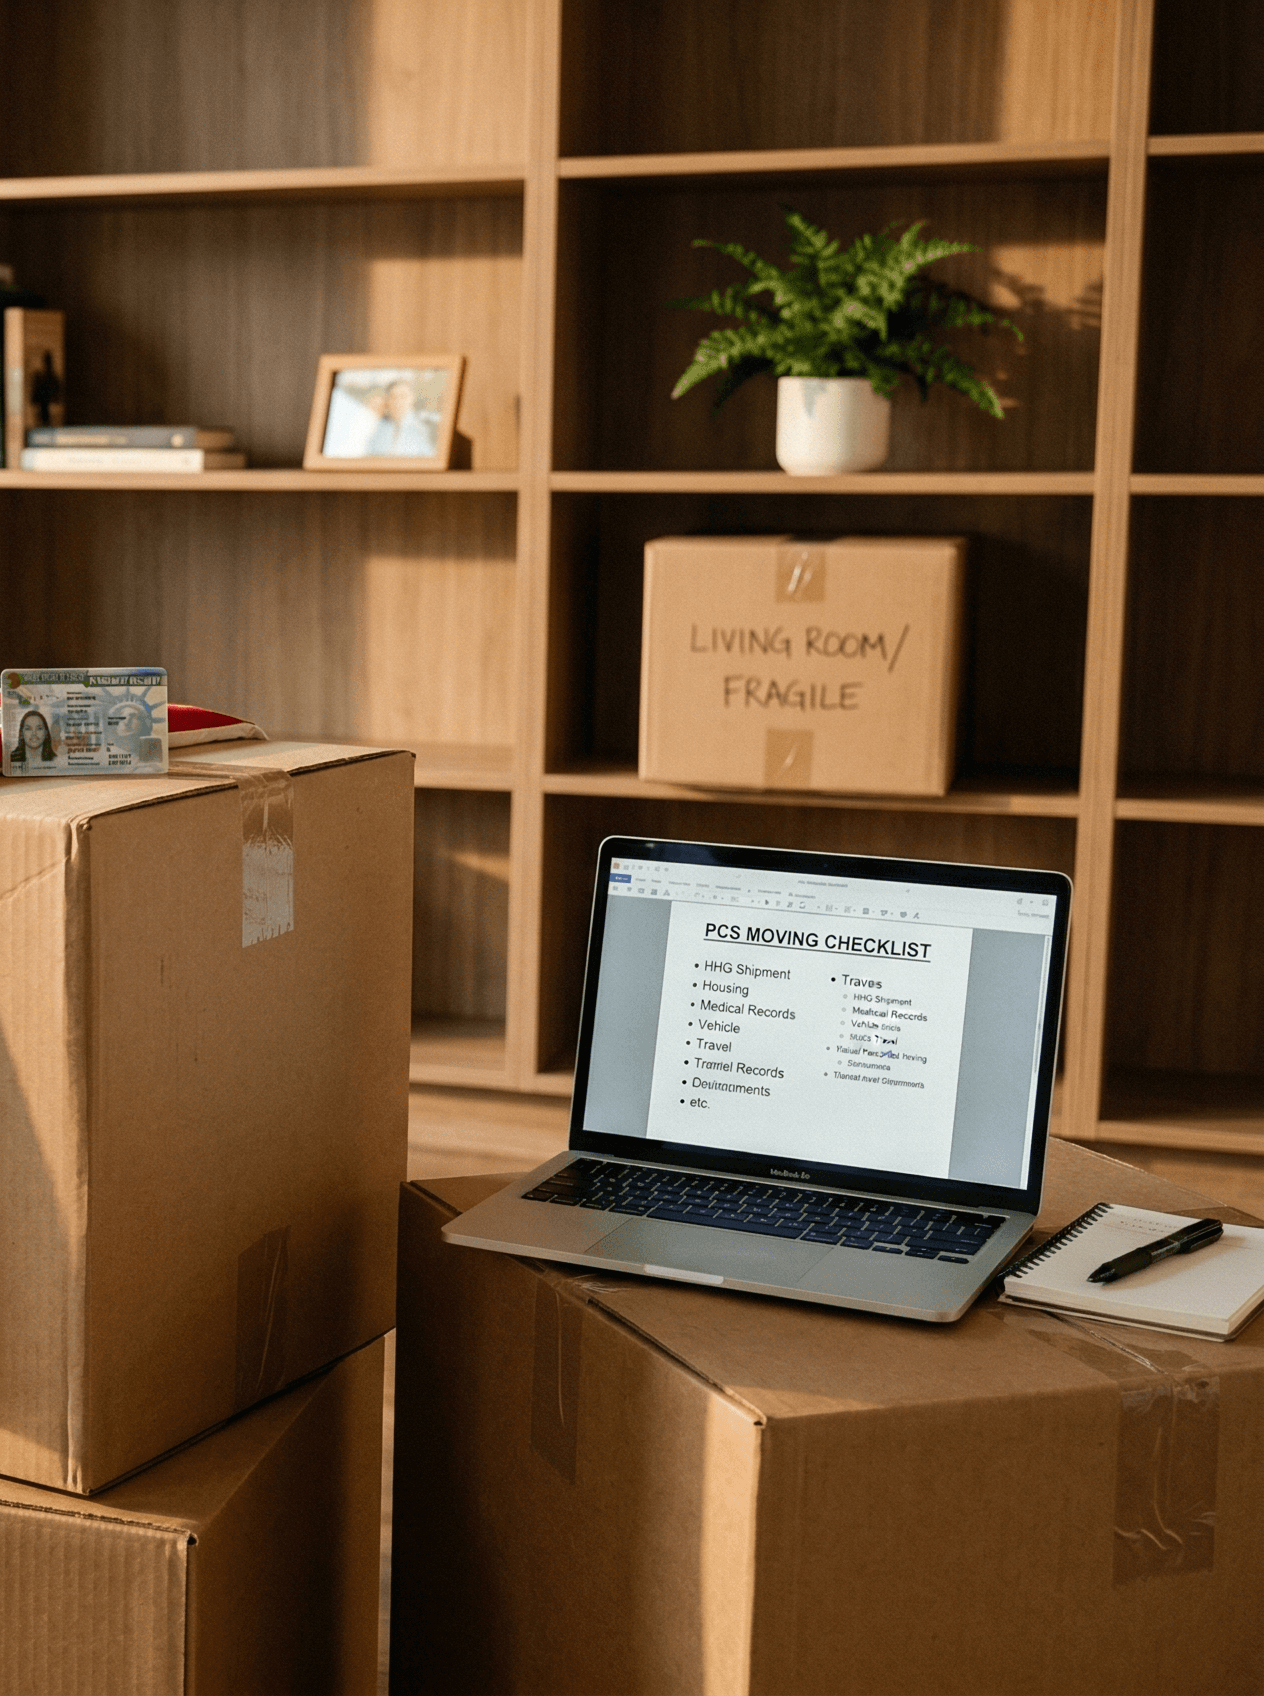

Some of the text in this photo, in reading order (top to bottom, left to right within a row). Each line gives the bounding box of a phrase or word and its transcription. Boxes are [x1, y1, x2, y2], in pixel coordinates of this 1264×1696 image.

[689, 622, 792, 660] LIVING
[723, 674, 864, 712] FRAGILE
[705, 922, 932, 959] PCS MOVING CHECKLIST
[704, 960, 791, 980] HHG Shipment
[702, 979, 750, 998] Housing
[700, 999, 796, 1020] Medical Records
[698, 1018, 741, 1034] Vehicle
[696, 1037, 732, 1053] Travel
[736, 1062, 785, 1079] Records
[689, 1097, 711, 1109] etc.
